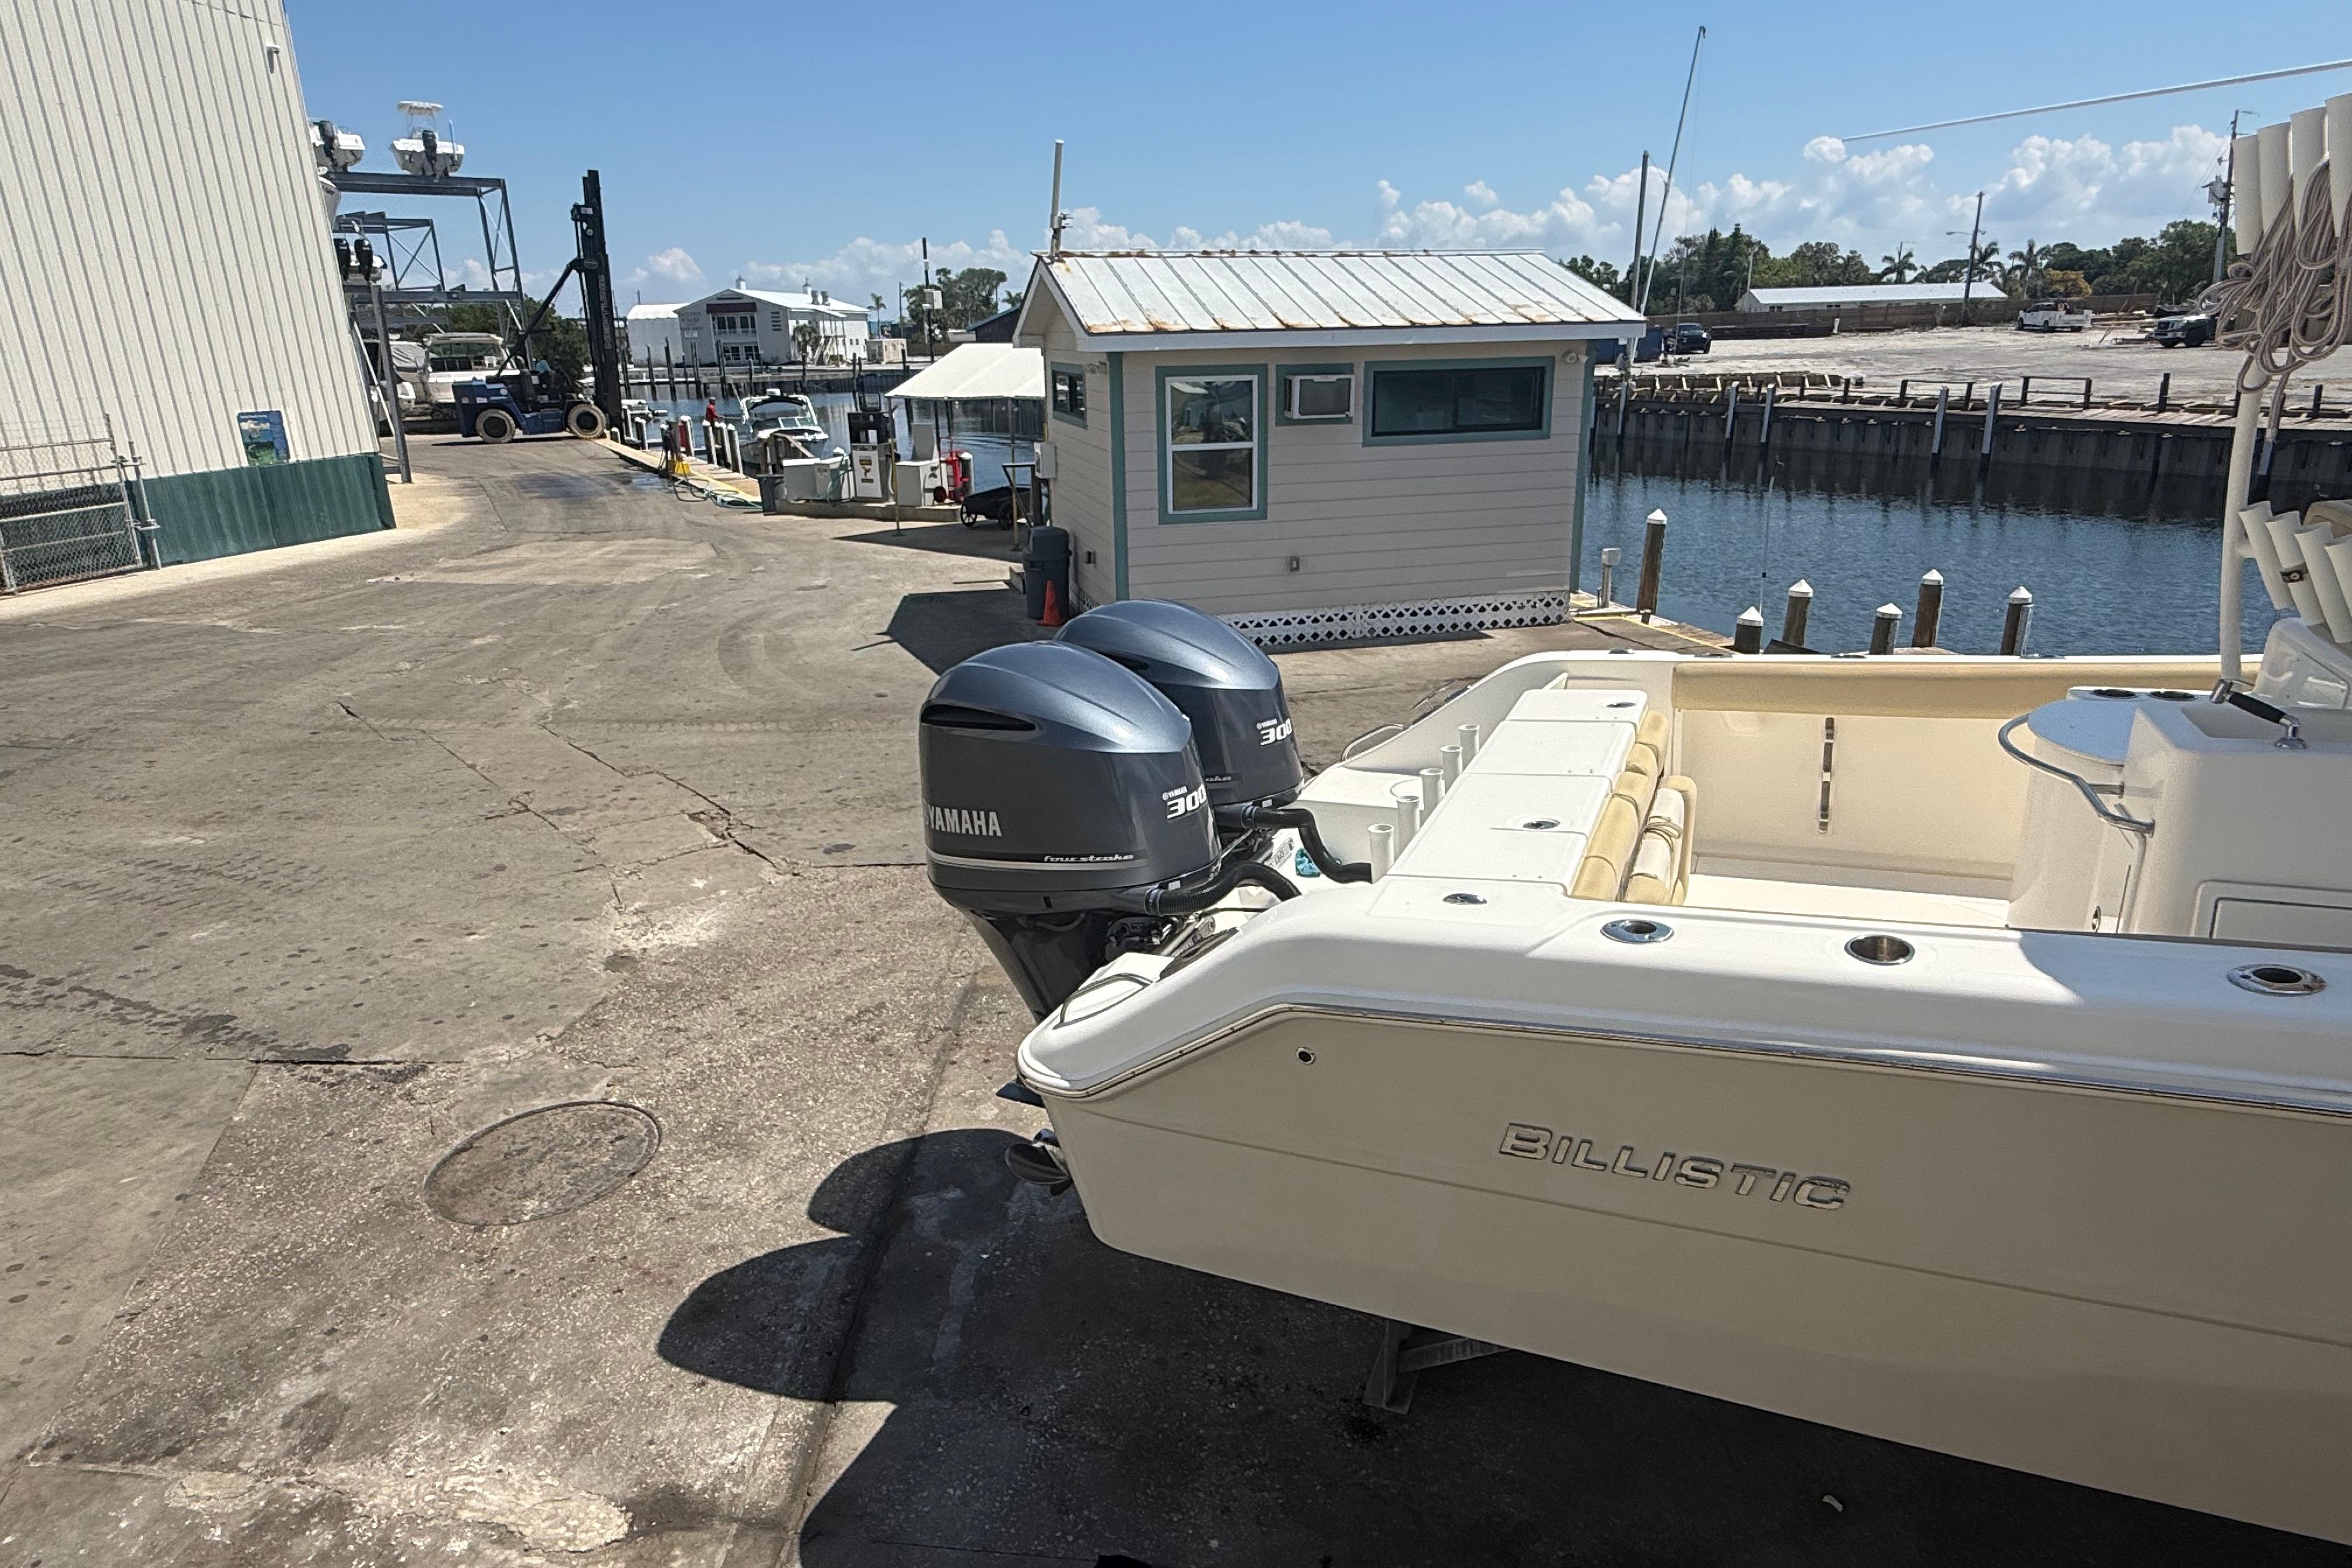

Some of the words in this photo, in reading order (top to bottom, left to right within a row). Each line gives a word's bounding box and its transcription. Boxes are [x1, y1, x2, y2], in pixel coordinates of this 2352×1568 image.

[1260, 718, 1293, 746] 300
[1167, 783, 1206, 819] 300
[927, 804, 1002, 837] YAMAHA
[1499, 1122, 1852, 1210] BILLISTIC
